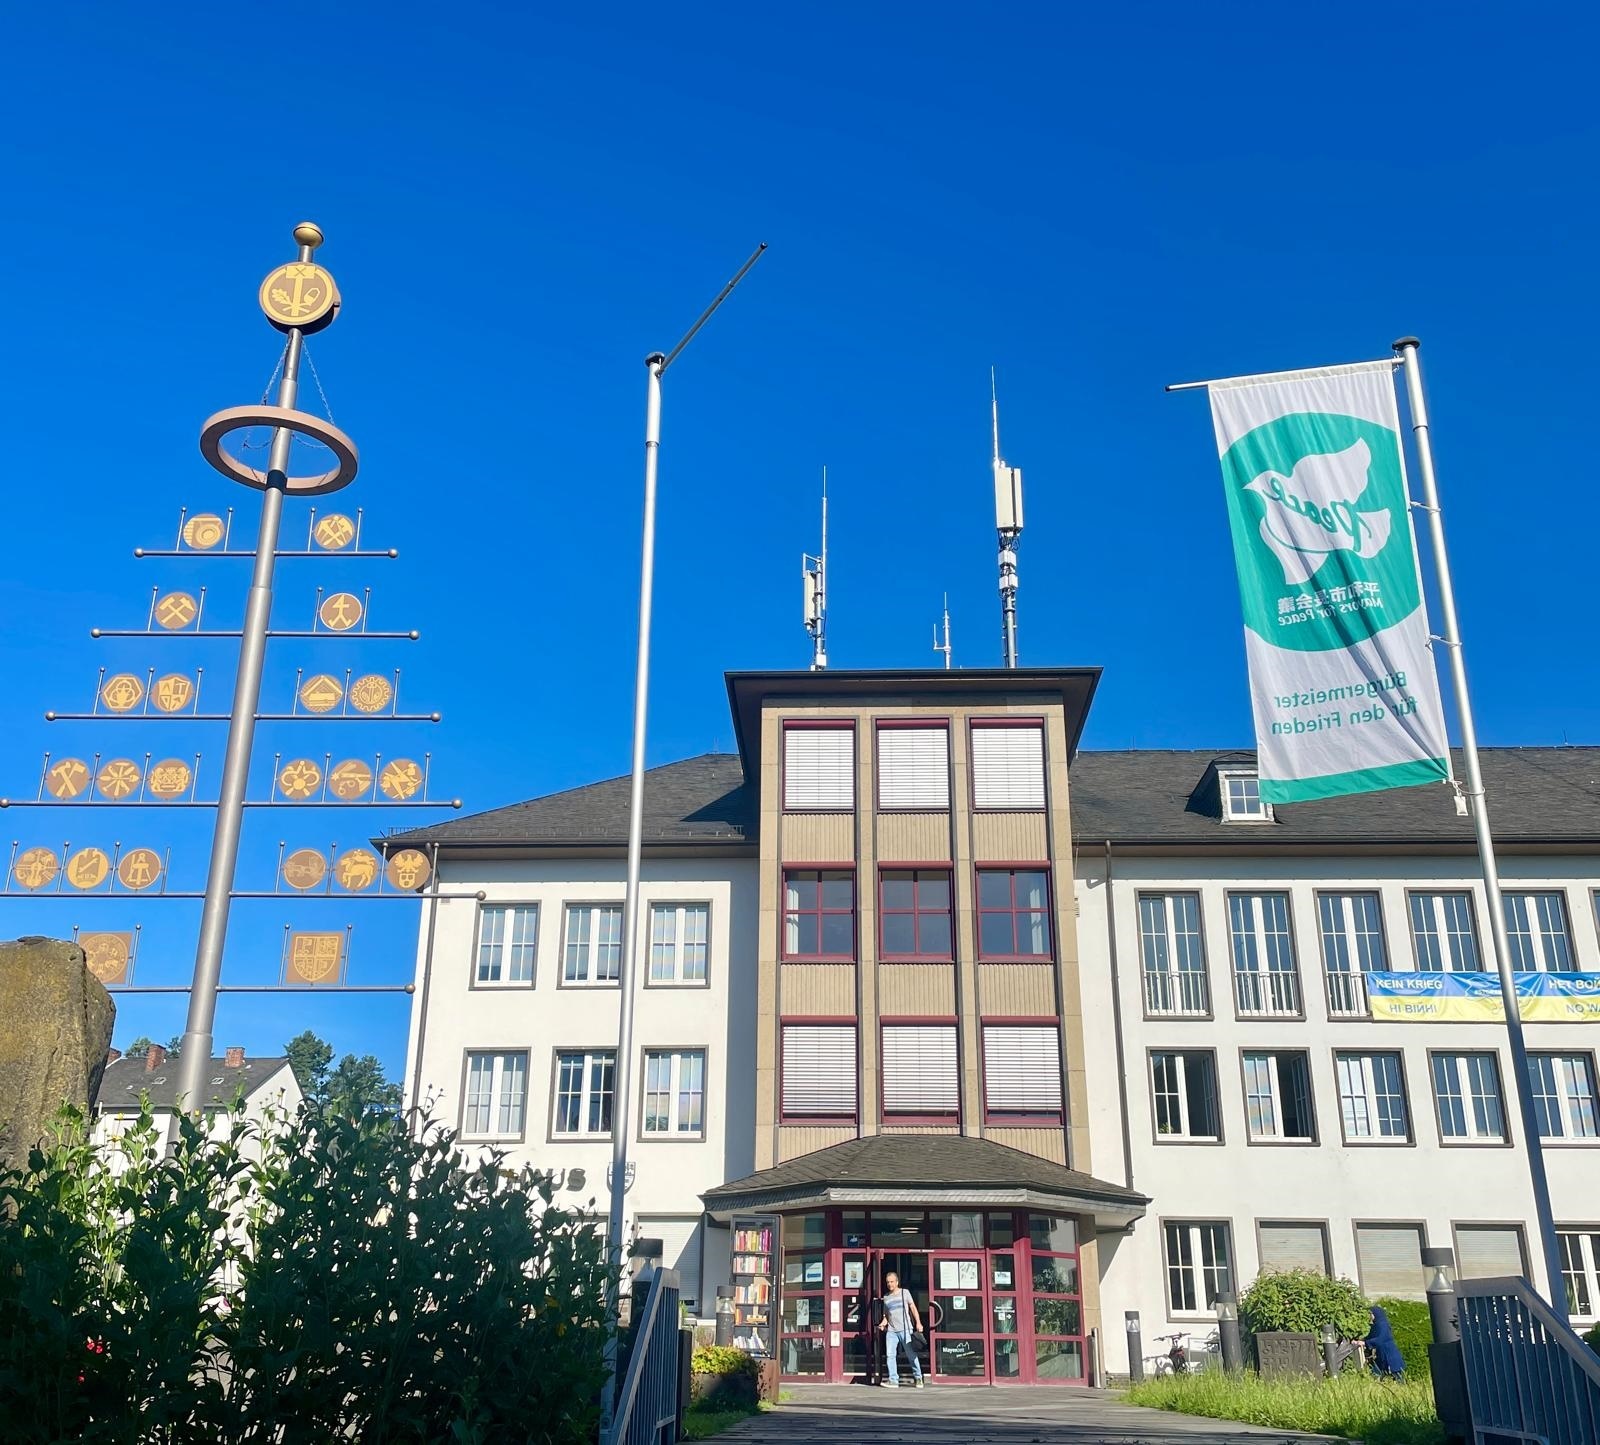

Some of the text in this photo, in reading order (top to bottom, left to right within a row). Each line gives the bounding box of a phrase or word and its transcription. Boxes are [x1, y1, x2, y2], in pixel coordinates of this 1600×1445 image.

[1376, 979, 1443, 990] KEIN KRIEG
[1566, 1003, 1600, 1014] NO W
